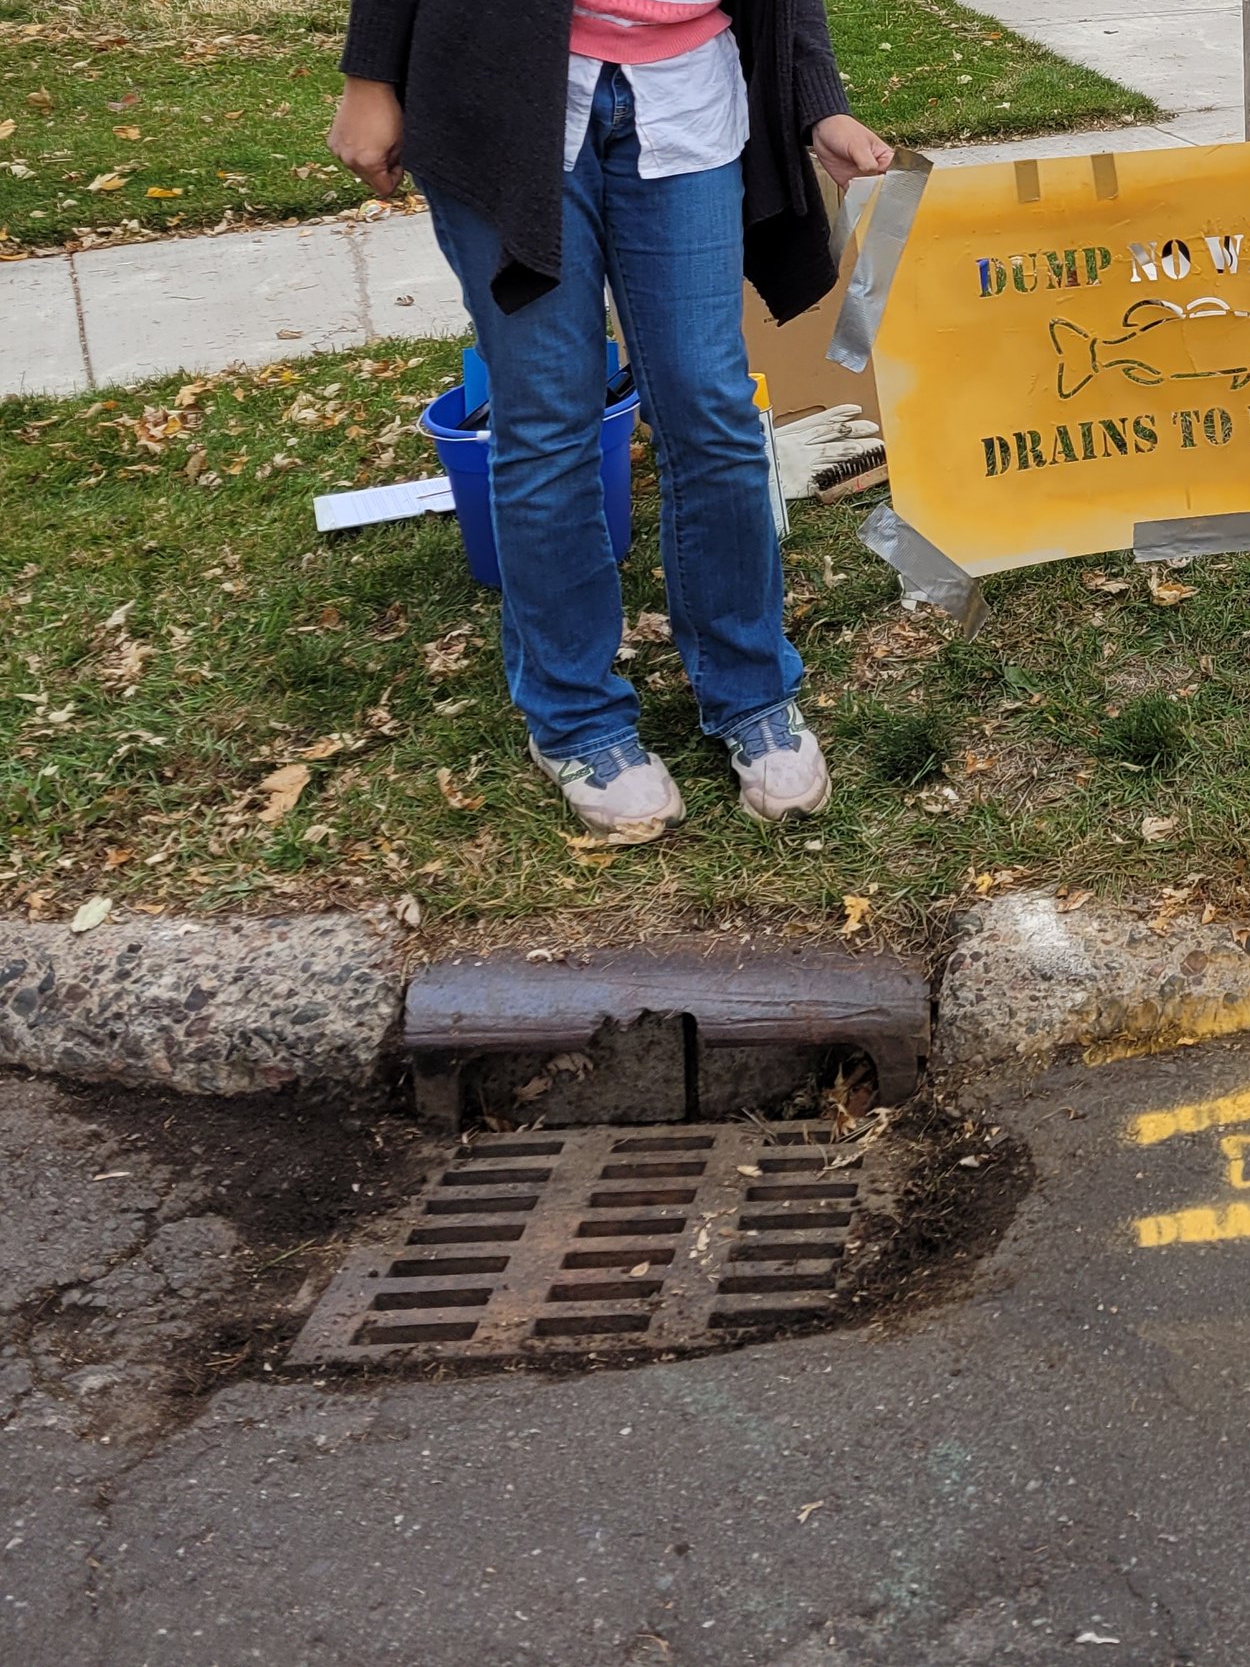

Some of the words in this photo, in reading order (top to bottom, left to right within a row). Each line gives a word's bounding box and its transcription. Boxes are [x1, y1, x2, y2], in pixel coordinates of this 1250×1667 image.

[975, 246, 1112, 298] DUMP
[1126, 238, 1192, 283] NO
[980, 413, 1160, 478] DRAINS
[1171, 405, 1234, 450] TO
